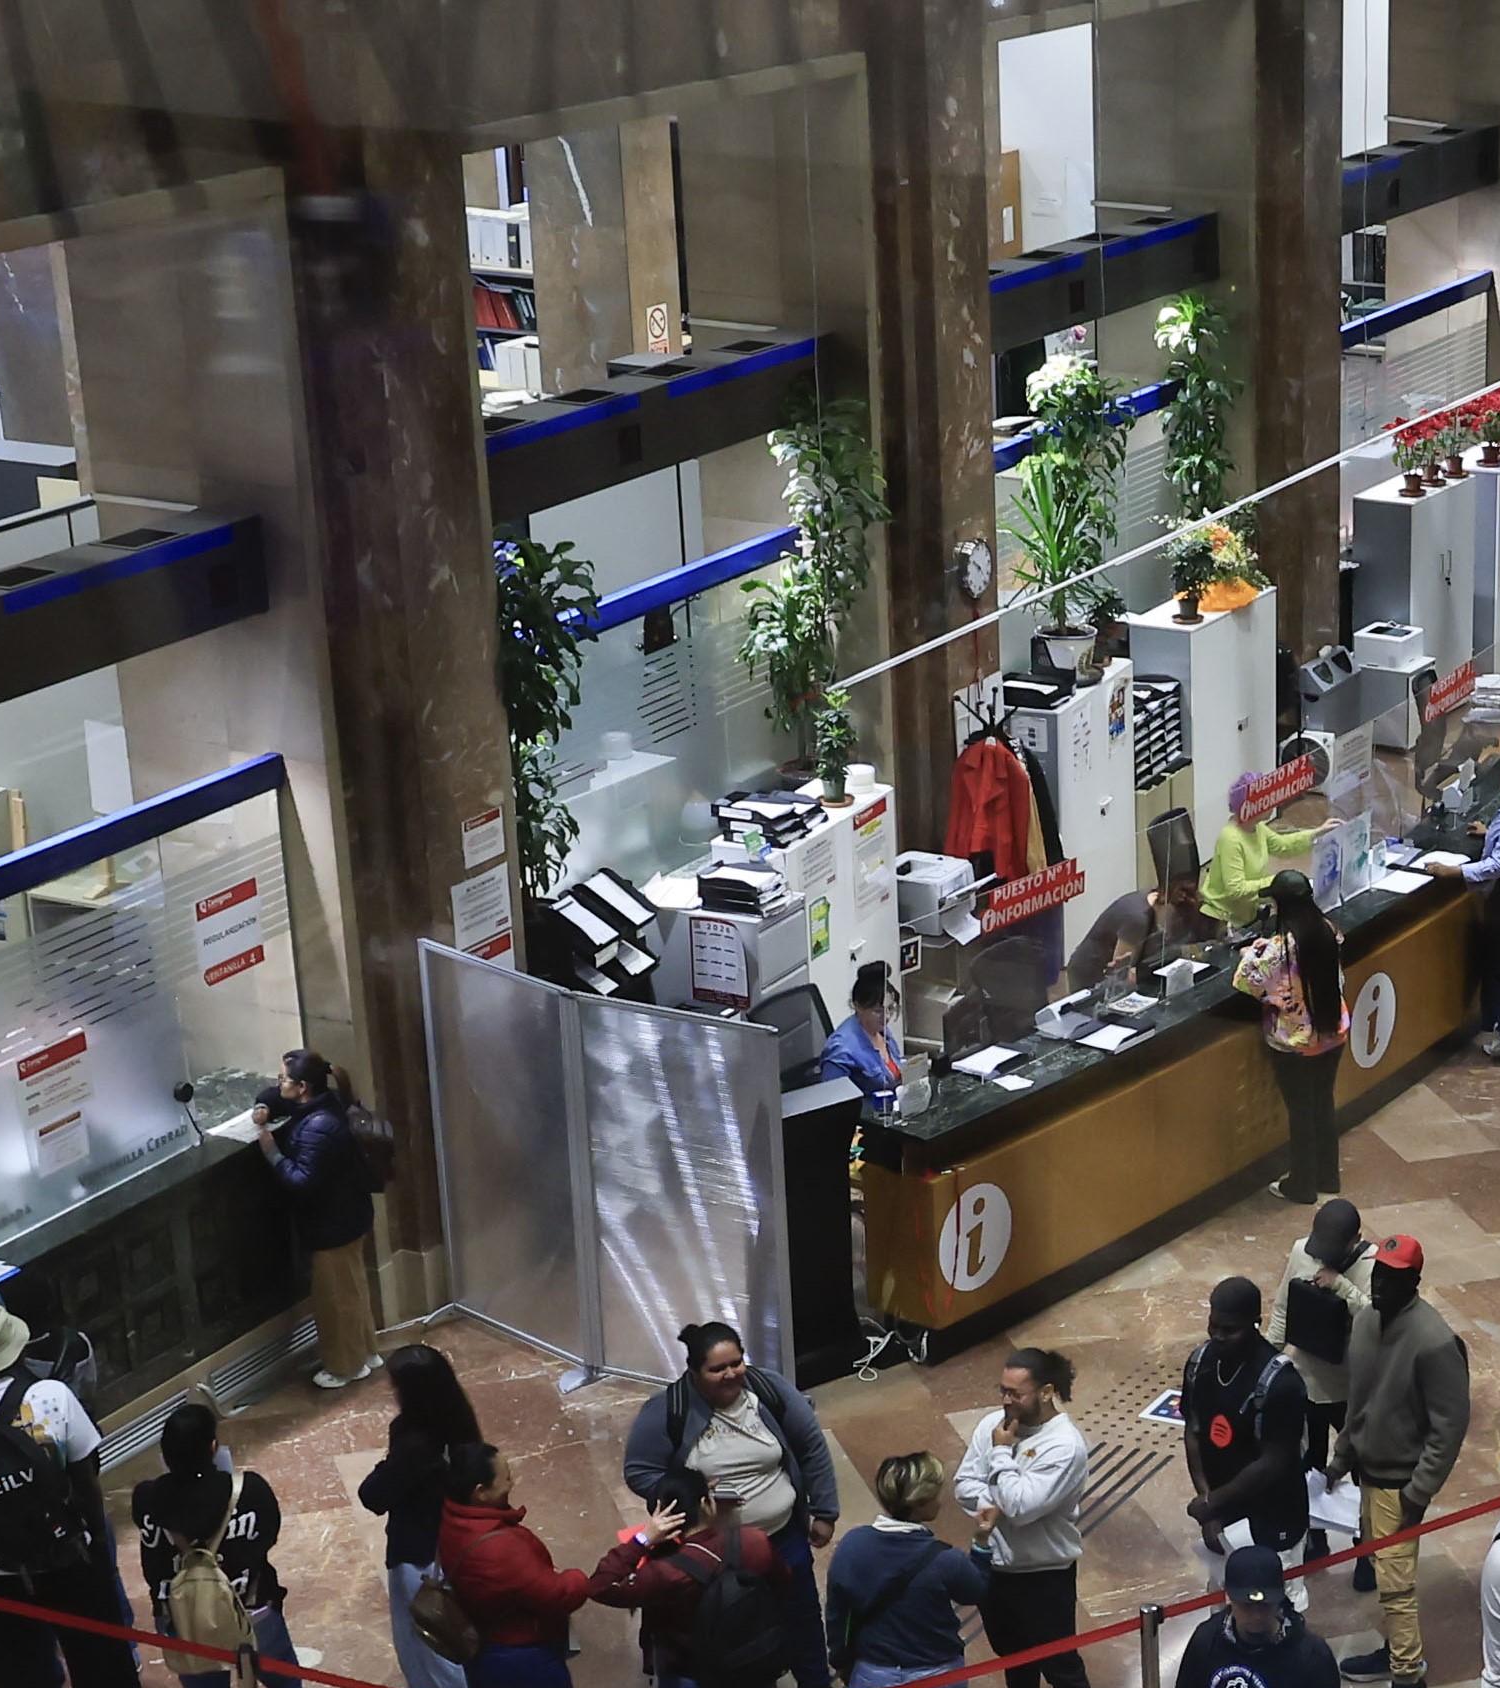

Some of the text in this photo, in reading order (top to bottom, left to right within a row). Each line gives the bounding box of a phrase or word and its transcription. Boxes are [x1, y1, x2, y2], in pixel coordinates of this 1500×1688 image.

[1248, 766, 1285, 796] PUESTO
[1300, 755, 1307, 770] 2
[993, 873, 1043, 904] PUESTO
[1066, 860, 1072, 875] 1
[706, 922, 731, 934] 2026
[250, 951, 257, 964] 4
